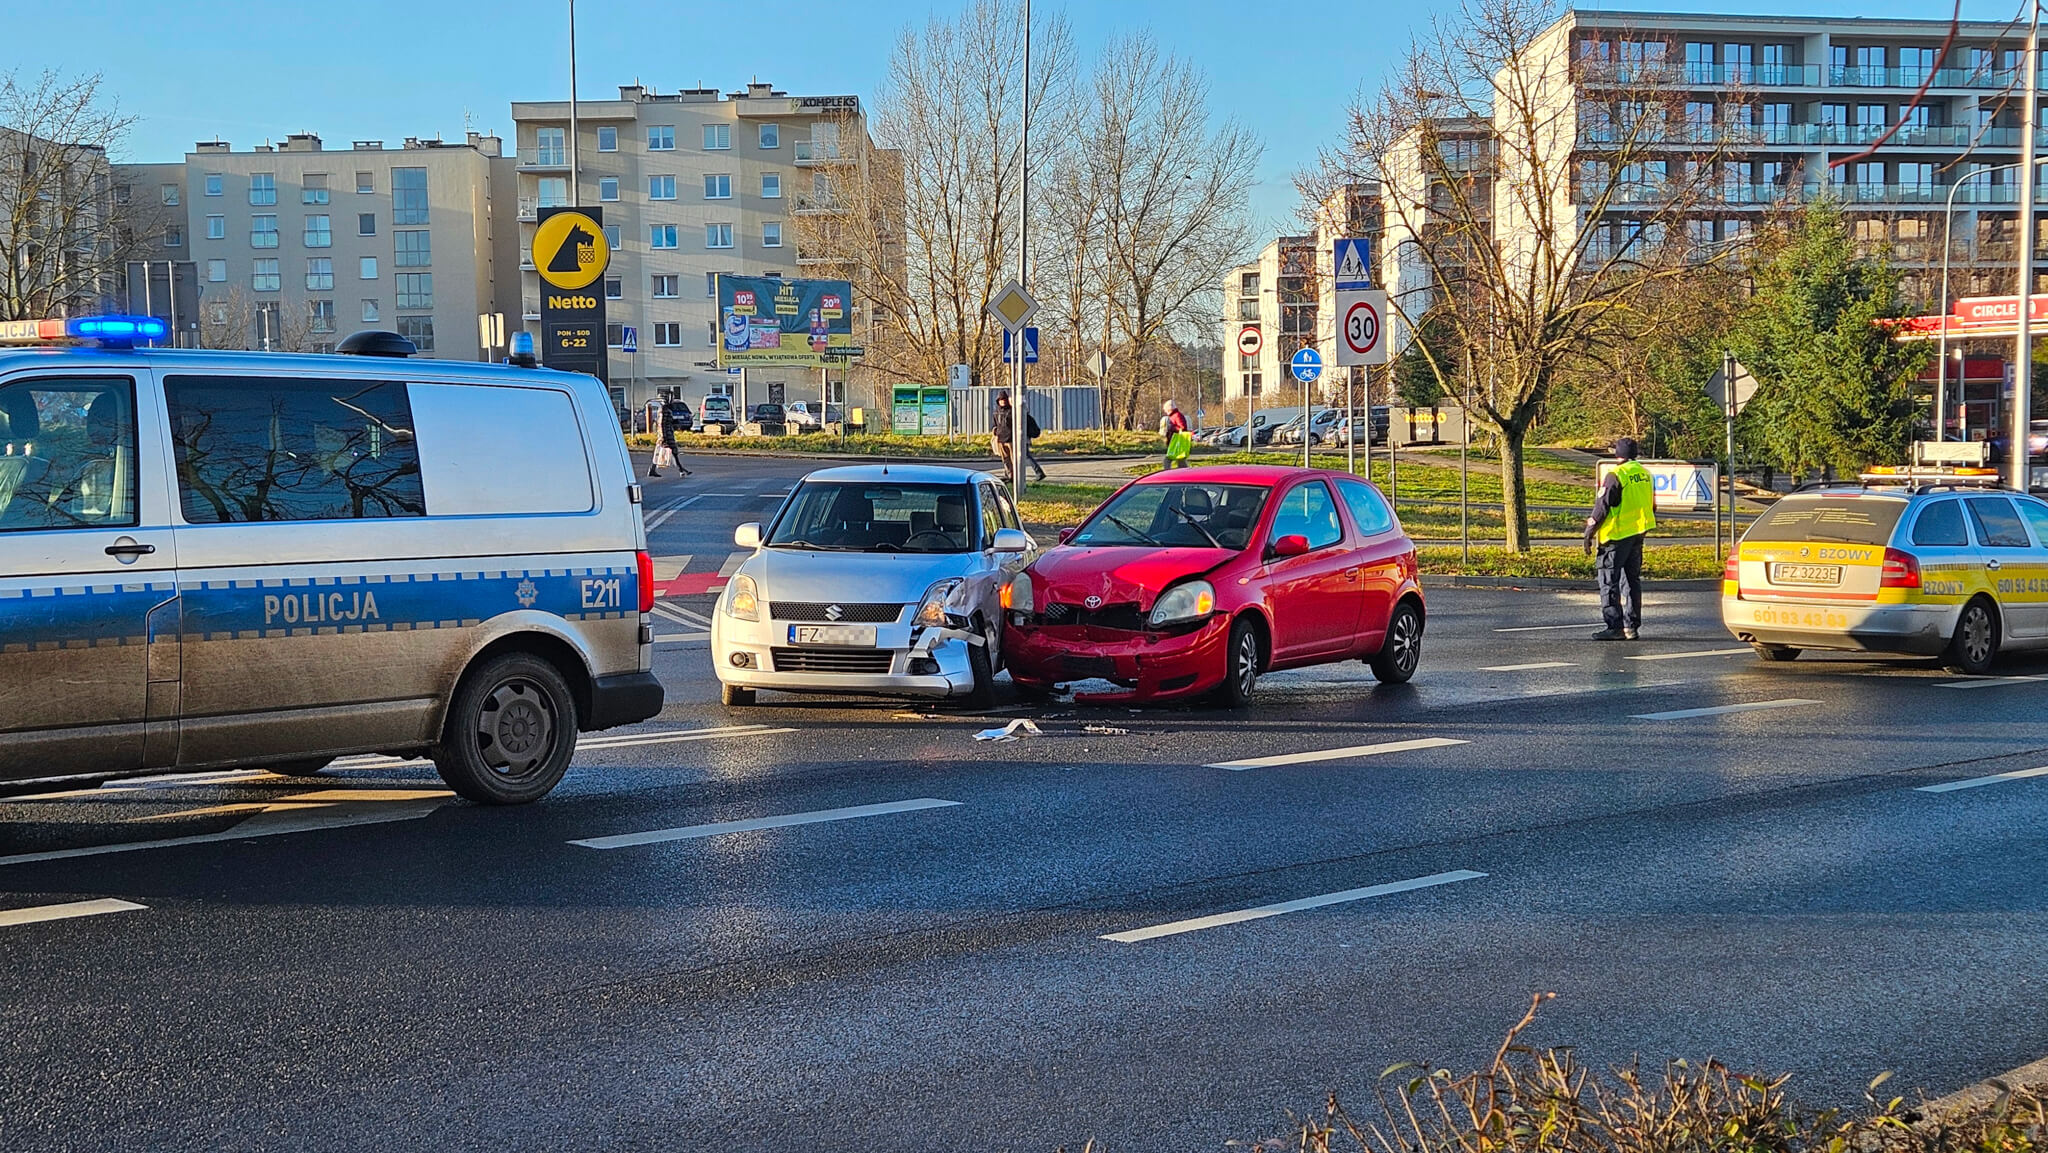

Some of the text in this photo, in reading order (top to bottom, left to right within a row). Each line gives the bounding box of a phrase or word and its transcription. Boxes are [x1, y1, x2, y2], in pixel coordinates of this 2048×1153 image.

[803, 97, 856, 107] KOMPLEKS
[779, 285, 794, 296] HIT
[548, 295, 597, 309] Netto
[1972, 303, 2017, 318] CIRCLE
[1350, 316, 1374, 340] 30
[561, 338, 587, 347] 6-22
[1404, 413, 1435, 423] Netto
[1819, 548, 1872, 560] BZOWY
[1781, 566, 1837, 580] FZ 3223E
[581, 578, 620, 608] E211
[1923, 580, 1965, 595] BZOWY
[264, 590, 380, 624] POLICJA
[1753, 609, 1777, 624] 601
